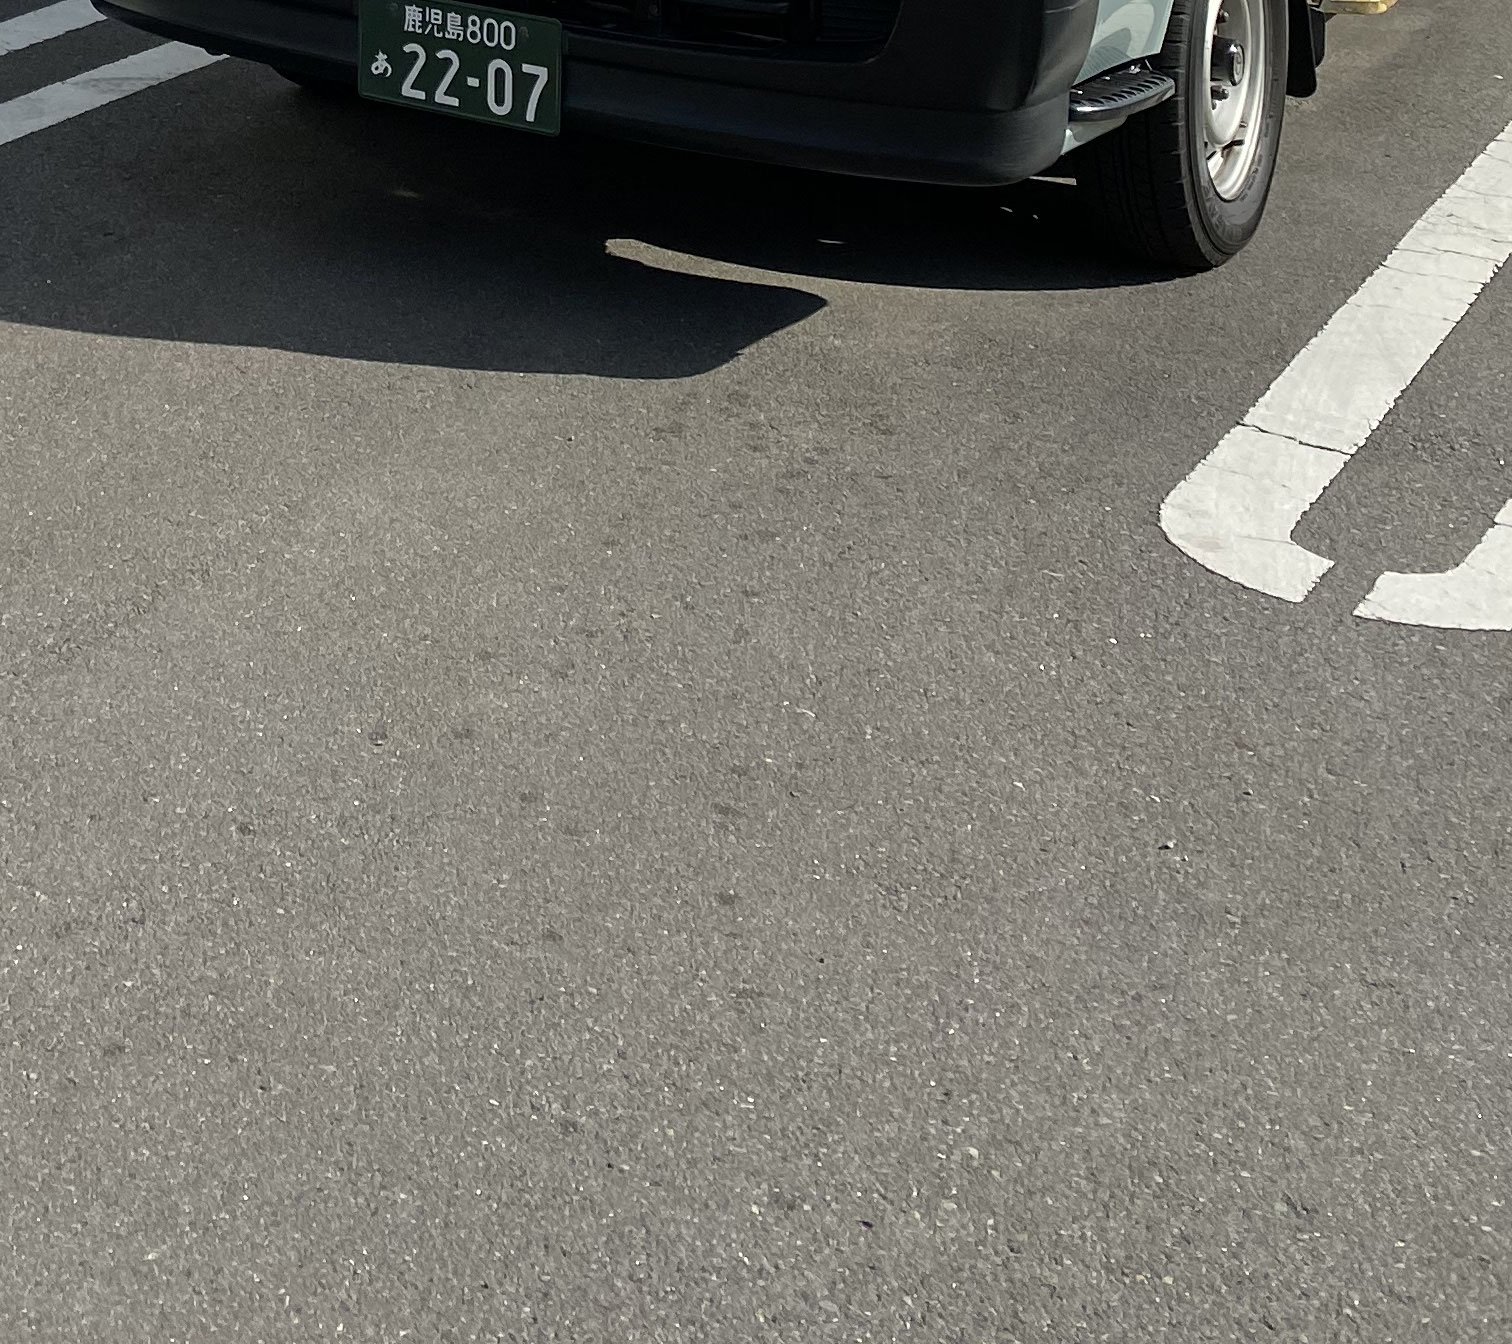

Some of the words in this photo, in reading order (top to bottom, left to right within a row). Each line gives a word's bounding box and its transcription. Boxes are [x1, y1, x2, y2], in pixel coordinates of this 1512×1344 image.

[404, 4, 517, 51] 鹿児島800
[370, 49, 393, 78] あ
[401, 42, 550, 123] 22-07
